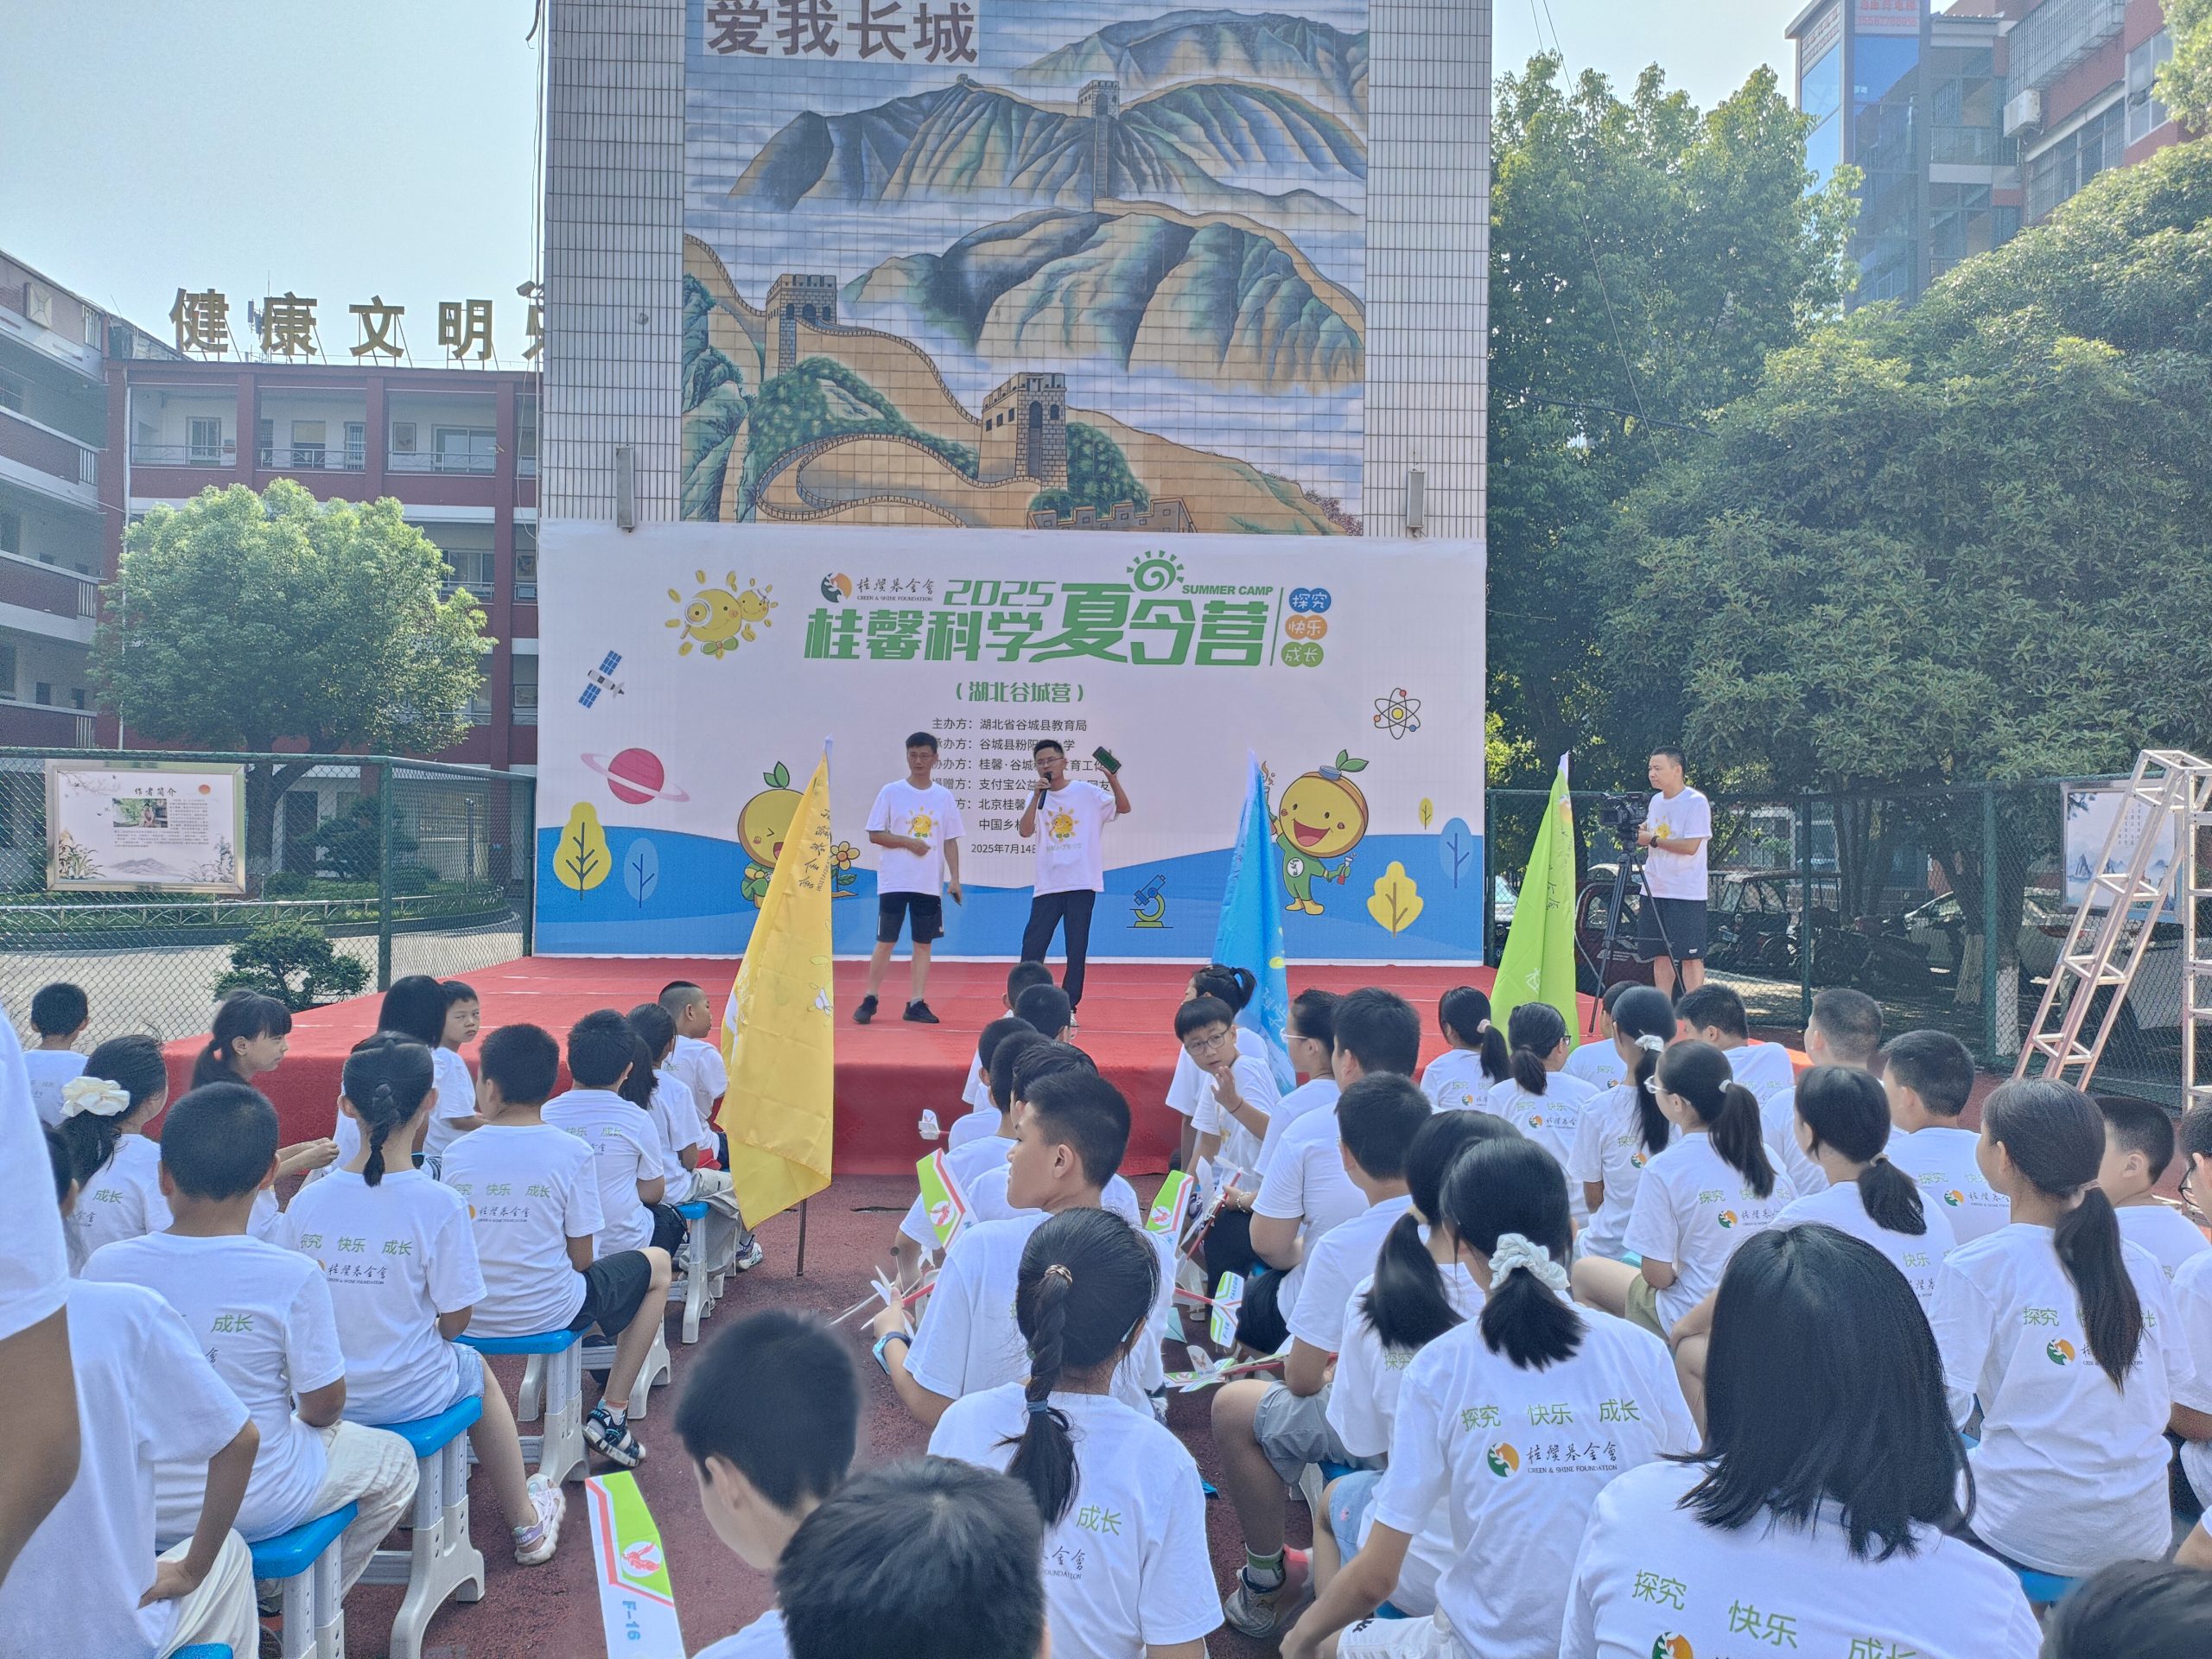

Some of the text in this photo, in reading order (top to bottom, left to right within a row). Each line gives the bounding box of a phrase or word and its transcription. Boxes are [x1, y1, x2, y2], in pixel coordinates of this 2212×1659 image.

[707, 0, 978, 64] 爱我长城
[944, 580, 1057, 607] 2025
[1182, 585, 1274, 596] SUMMER CAMP
[1292, 592, 1328, 609] 探究
[804, 582, 1269, 666] 桂馨科学夏令营
[1288, 620, 1321, 636] 快乐
[1285, 646, 1319, 663] 成长
[92, 1189, 124, 1204] 成长
[486, 1183, 512, 1197] 快乐
[525, 1185, 551, 1198] 成长
[337, 1236, 366, 1253] 快乐
[382, 1240, 413, 1255] 成长
[1903, 1252, 1931, 1268] 快乐
[211, 1314, 254, 1334] 成长
[2023, 1307, 2060, 1326] 探究
[1461, 1398, 1640, 1432] 探究 快乐 成长
[1077, 1504, 1122, 1536] 成长
[1631, 1569, 1687, 1611] 探究
[622, 1600, 641, 1640] F-16
[1727, 1600, 1798, 1649] 快乐
